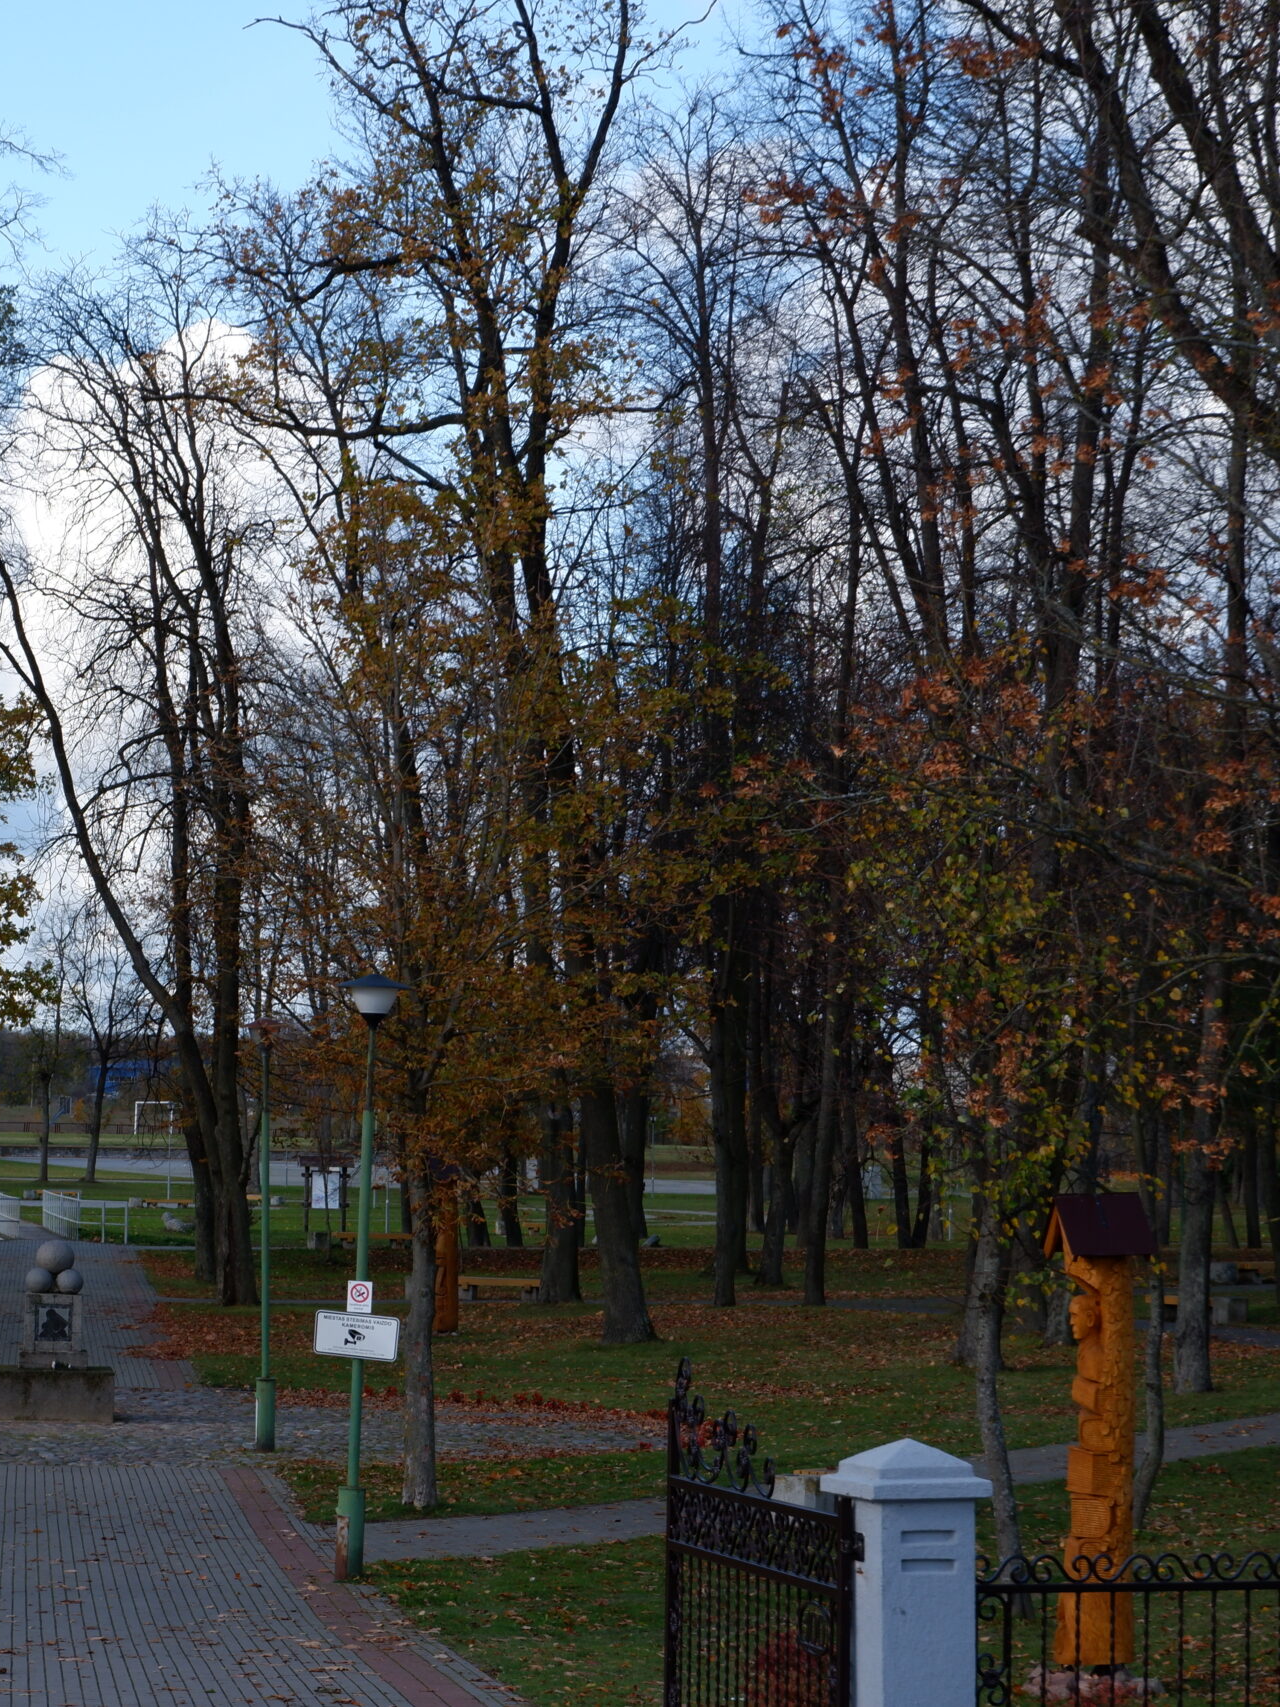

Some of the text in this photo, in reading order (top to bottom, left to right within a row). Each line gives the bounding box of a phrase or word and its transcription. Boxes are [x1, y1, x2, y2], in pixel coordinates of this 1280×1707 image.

[323, 1314, 345, 1322] MIESTAS
[372, 1319, 392, 1327] VAIZDO
[341, 1322, 375, 1330] KAMEROMIS
